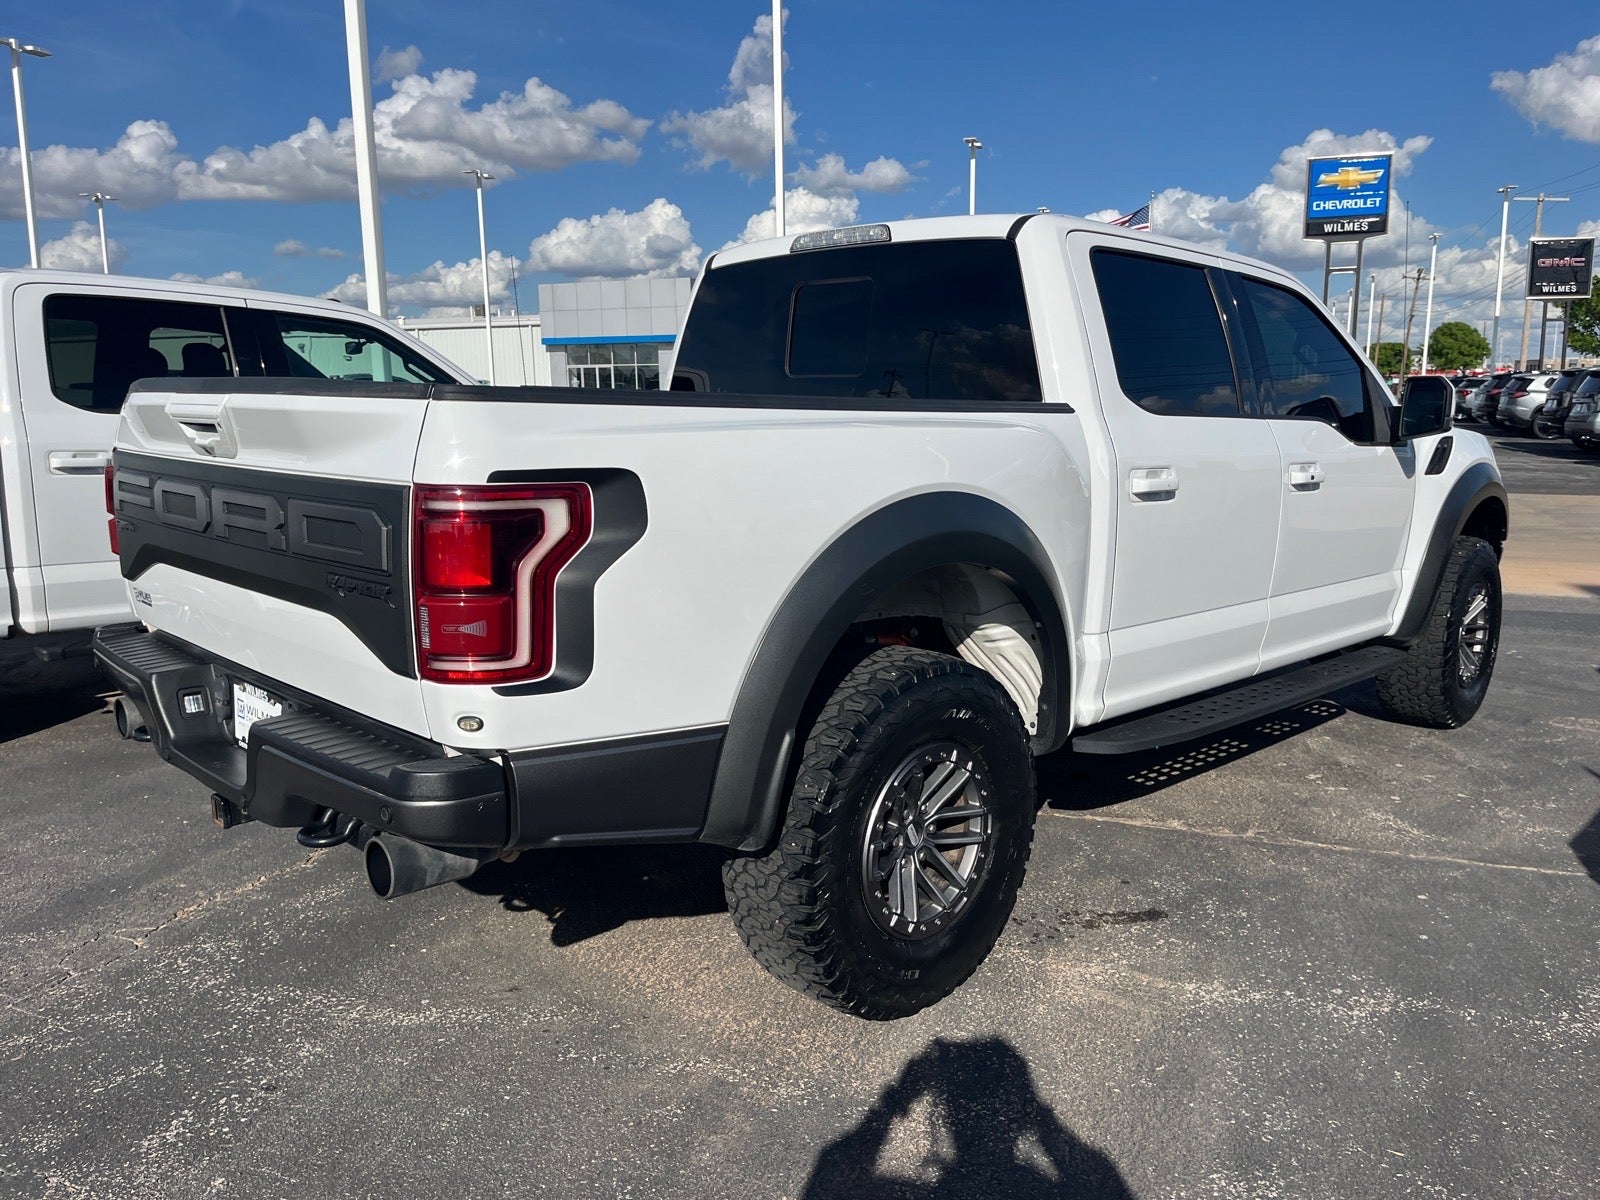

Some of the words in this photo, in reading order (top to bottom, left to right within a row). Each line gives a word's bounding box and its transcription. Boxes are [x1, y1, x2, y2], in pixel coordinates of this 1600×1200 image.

[1312, 197, 1382, 211] CHEVROLET
[1323, 221, 1369, 233] WILMES
[1537, 257, 1586, 268] GMC
[1541, 285, 1577, 293] WILMES
[114, 470, 393, 577] FORD
